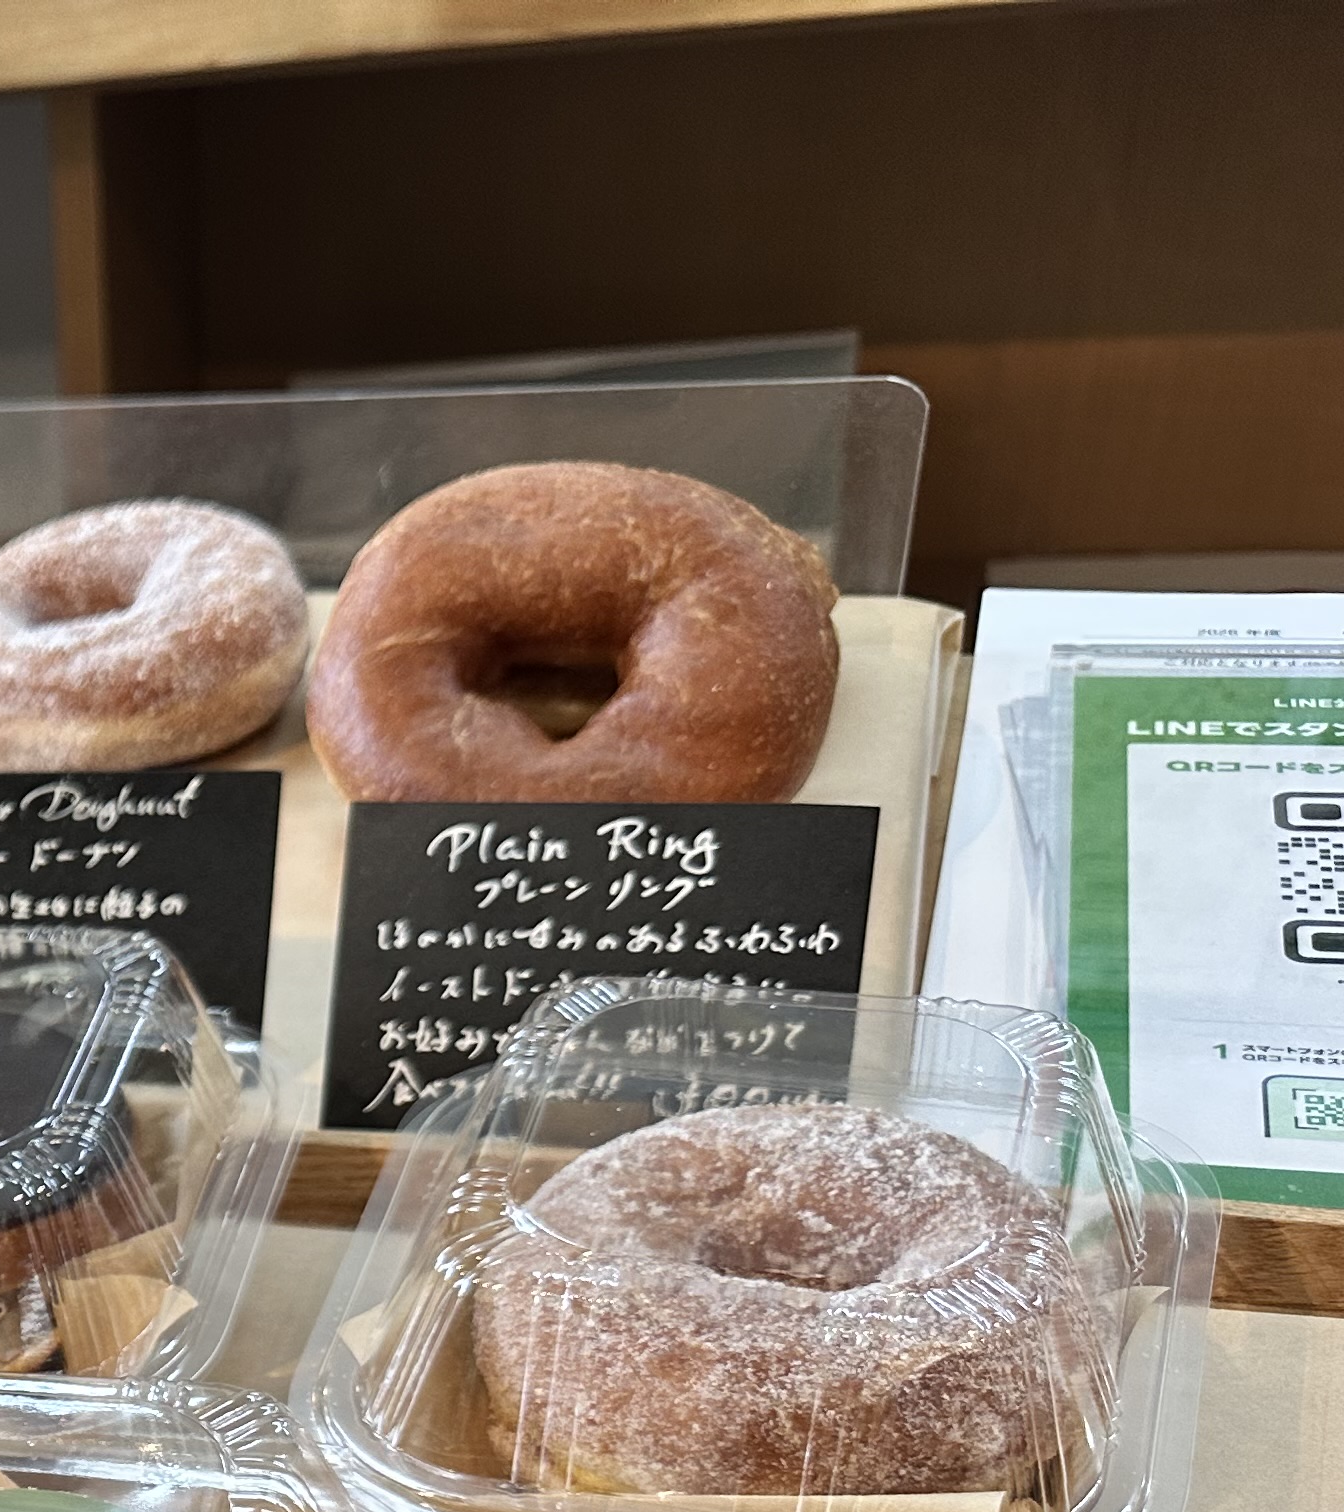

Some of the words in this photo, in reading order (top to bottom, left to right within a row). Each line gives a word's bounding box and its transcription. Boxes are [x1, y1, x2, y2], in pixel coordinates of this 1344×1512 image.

[20, 775, 205, 831] Doughnut
[427, 823, 569, 872] Plain
[597, 816, 721, 876] Ring
[474, 870, 593, 908] プレーン
[608, 876, 717, 911] リング
[1213, 1043, 1227, 1059] 1
[1242, 1044, 1344, 1057] スマートフォン
[1242, 1053, 1344, 1065] QRコードをス
